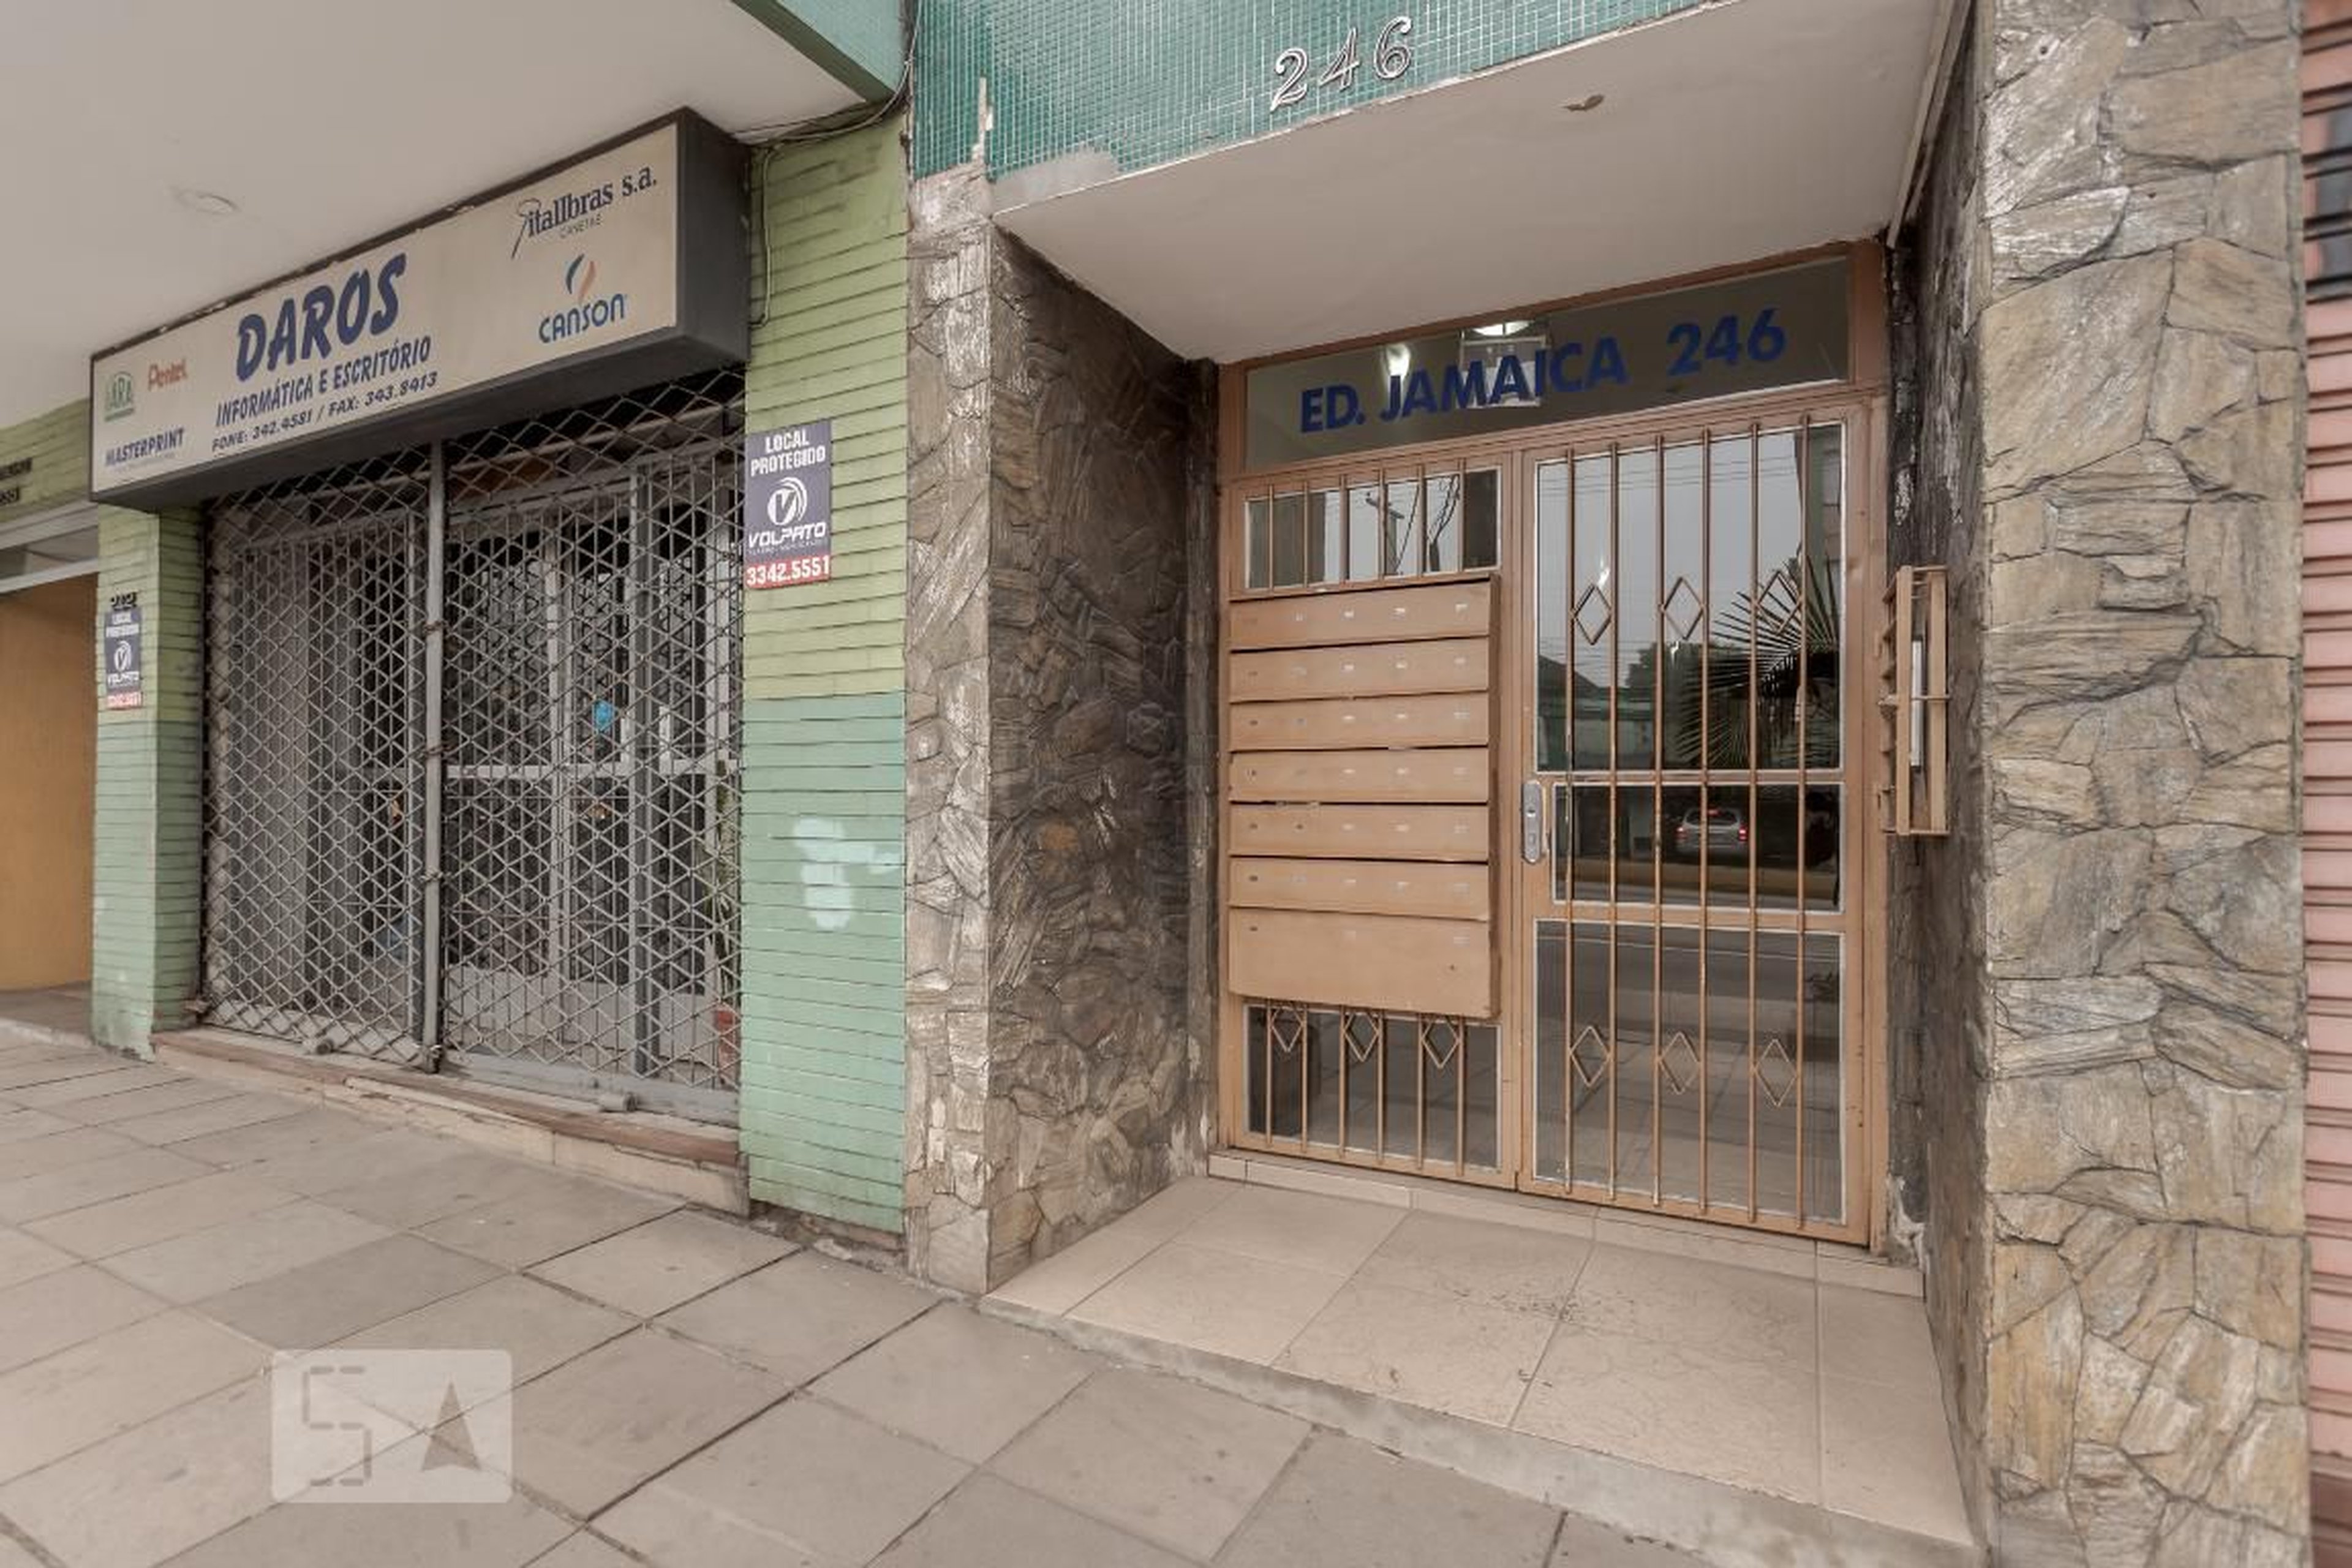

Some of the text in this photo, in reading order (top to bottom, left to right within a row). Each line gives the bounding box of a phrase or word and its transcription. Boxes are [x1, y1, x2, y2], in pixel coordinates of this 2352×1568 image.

[1270, 16, 1414, 111] 246
[622, 166, 657, 197] s.a.
[236, 252, 407, 382] DAROS
[216, 335, 431, 428] INFORMÁTICA E ESCRITÓRIO
[1300, 306, 1787, 434] ED. JAMAICA 246
[211, 431, 249, 453] FONE:
[328, 396, 360, 417] FAX:
[765, 429, 810, 454] LOCAL
[105, 428, 185, 467] MASTERPRINT
[750, 445, 826, 477] PROTEGIDO
[748, 522, 827, 548] VOLPATO
[747, 555, 830, 586] 3342.5551
